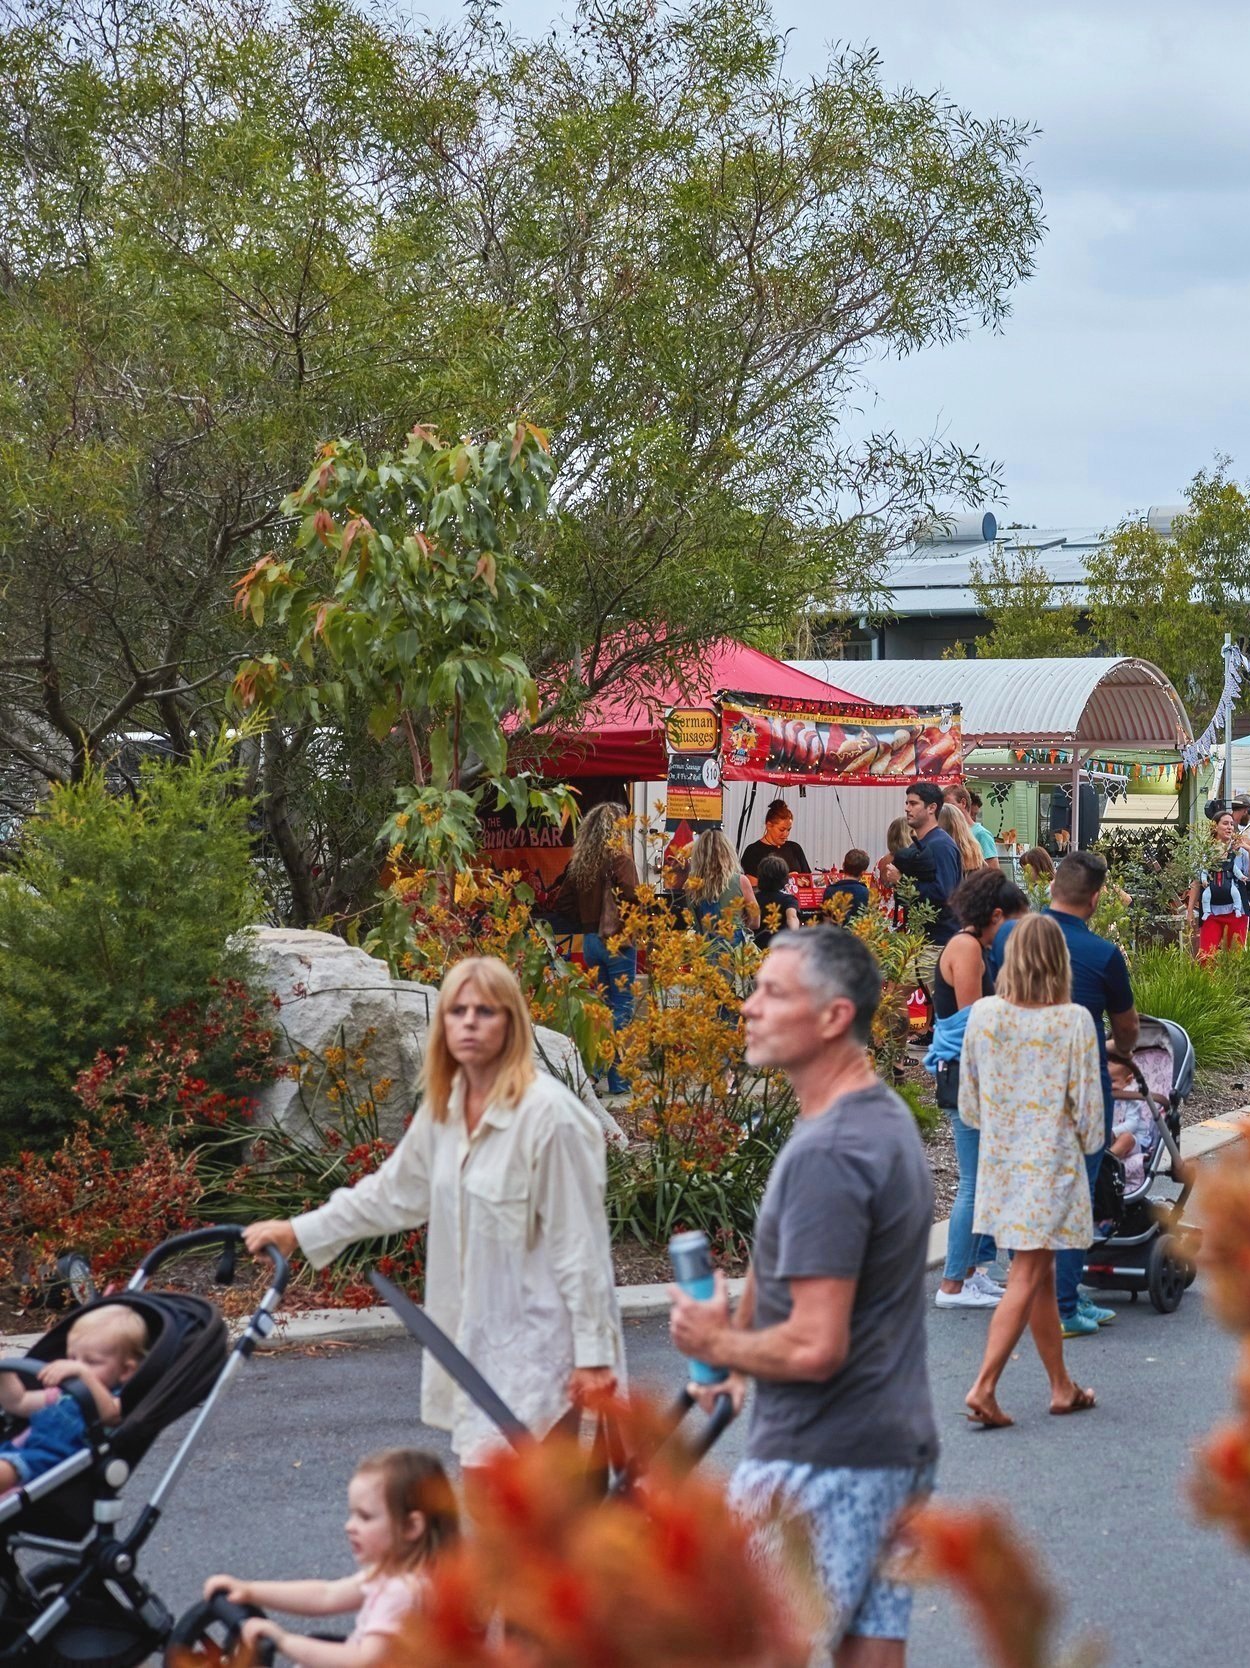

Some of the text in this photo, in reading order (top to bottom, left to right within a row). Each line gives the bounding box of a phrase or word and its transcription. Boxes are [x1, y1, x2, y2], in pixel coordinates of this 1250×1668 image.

[767, 697, 919, 720] GERMAN SAUSAG
[676, 732, 714, 746] ausages
[706, 766, 718, 781] $10
[488, 818, 501, 827] THE
[529, 826, 563, 846] BAR
